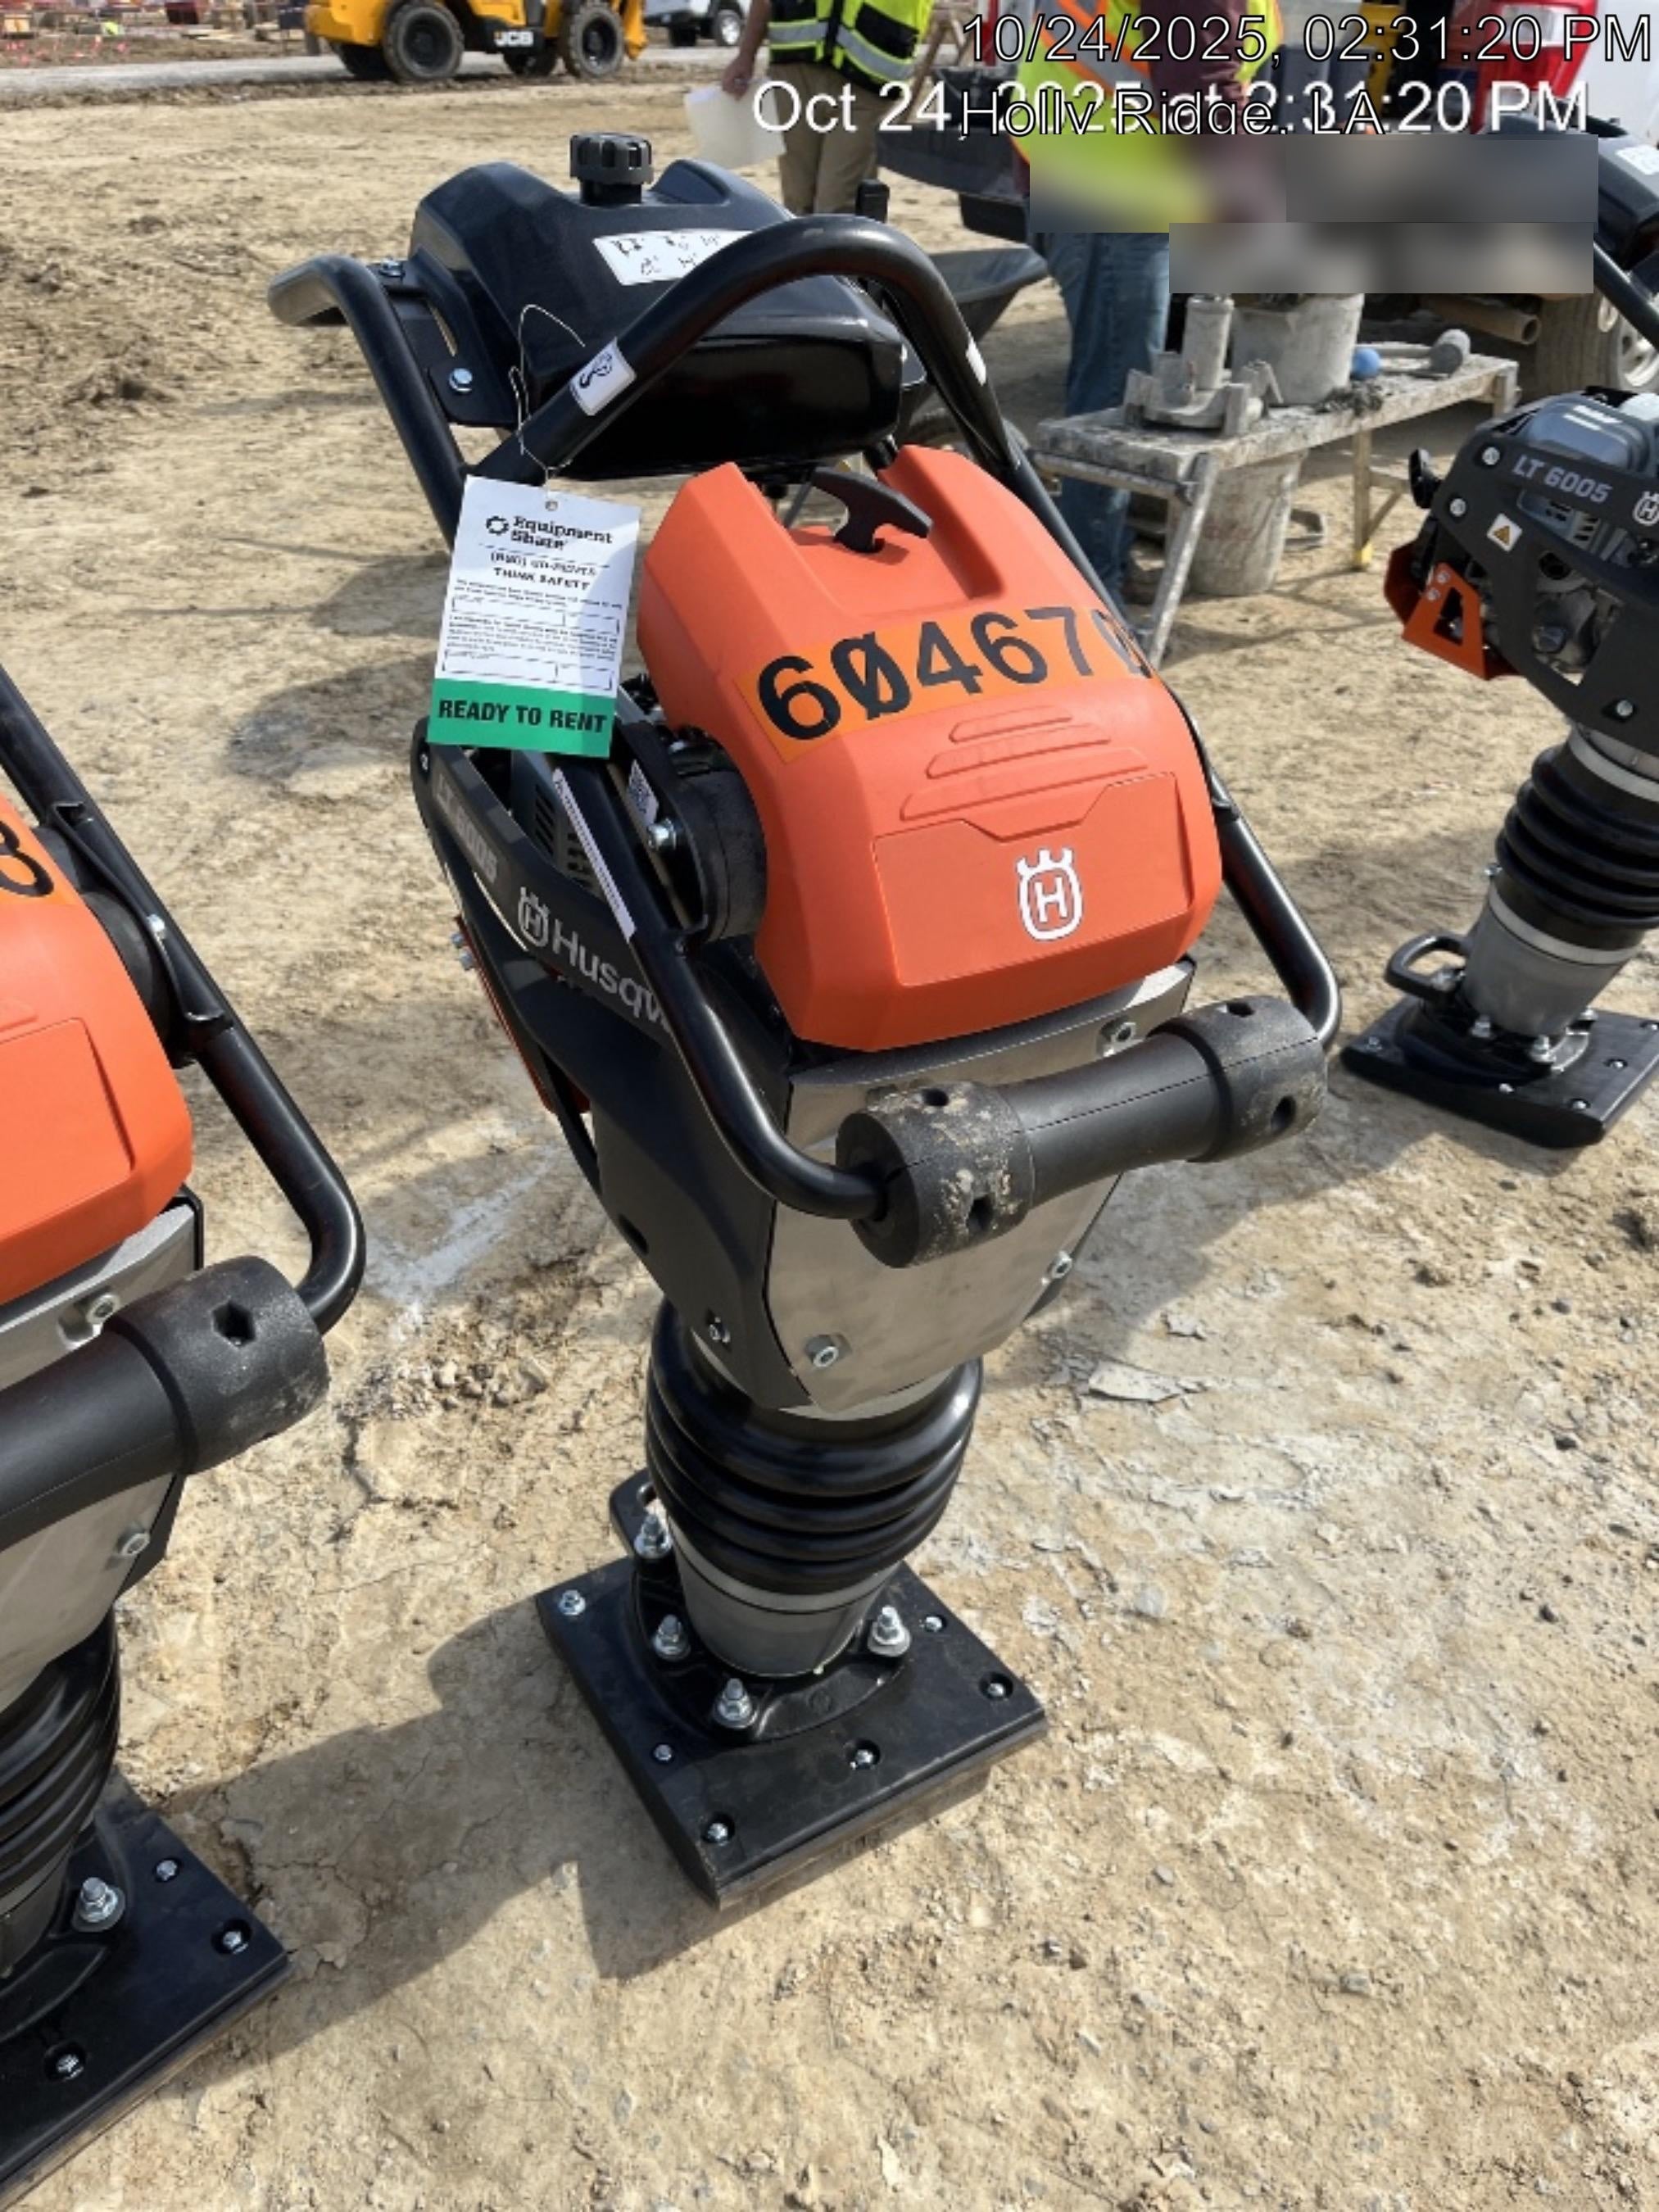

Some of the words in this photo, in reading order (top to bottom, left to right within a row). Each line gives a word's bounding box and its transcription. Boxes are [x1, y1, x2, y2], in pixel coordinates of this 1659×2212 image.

[493, 30, 534, 47] JCB
[1512, 454, 1546, 479] LT
[1543, 466, 1613, 503] 6005
[512, 515, 613, 544] Equipment
[493, 567, 536, 582] THINK
[539, 574, 591, 591] SAFETY
[438, 700, 510, 723] READY
[516, 705, 542, 726] TO
[550, 709, 608, 733] RENT
